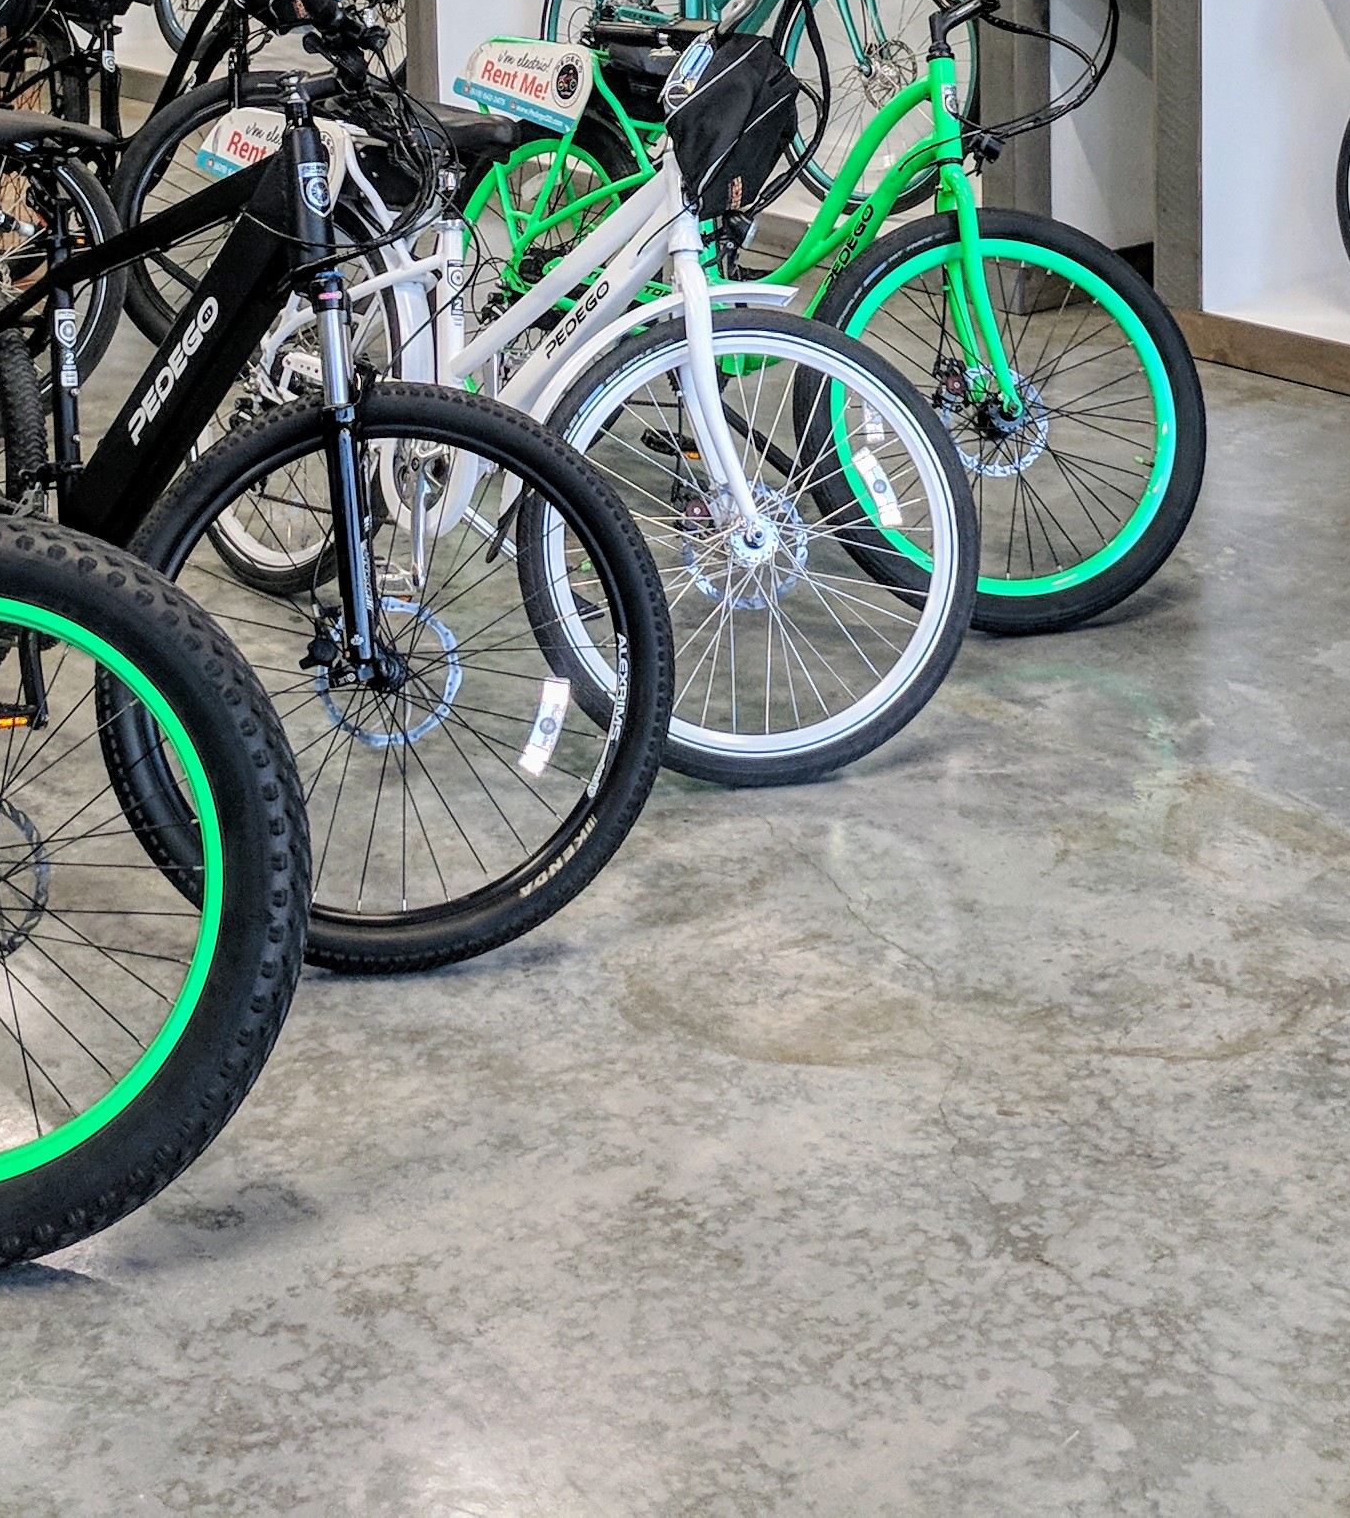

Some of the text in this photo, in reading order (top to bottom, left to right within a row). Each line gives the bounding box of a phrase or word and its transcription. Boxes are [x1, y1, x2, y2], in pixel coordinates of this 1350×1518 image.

[481, 60, 550, 100] Rent Me!
[226, 130, 267, 162] Rent
[545, 280, 609, 360] PEDEGO
[65, 352, 75, 365] 2
[127, 296, 220, 447] PEDEGO
[610, 632, 630, 742] ALEXRIMS
[519, 826, 591, 899] KENDA
